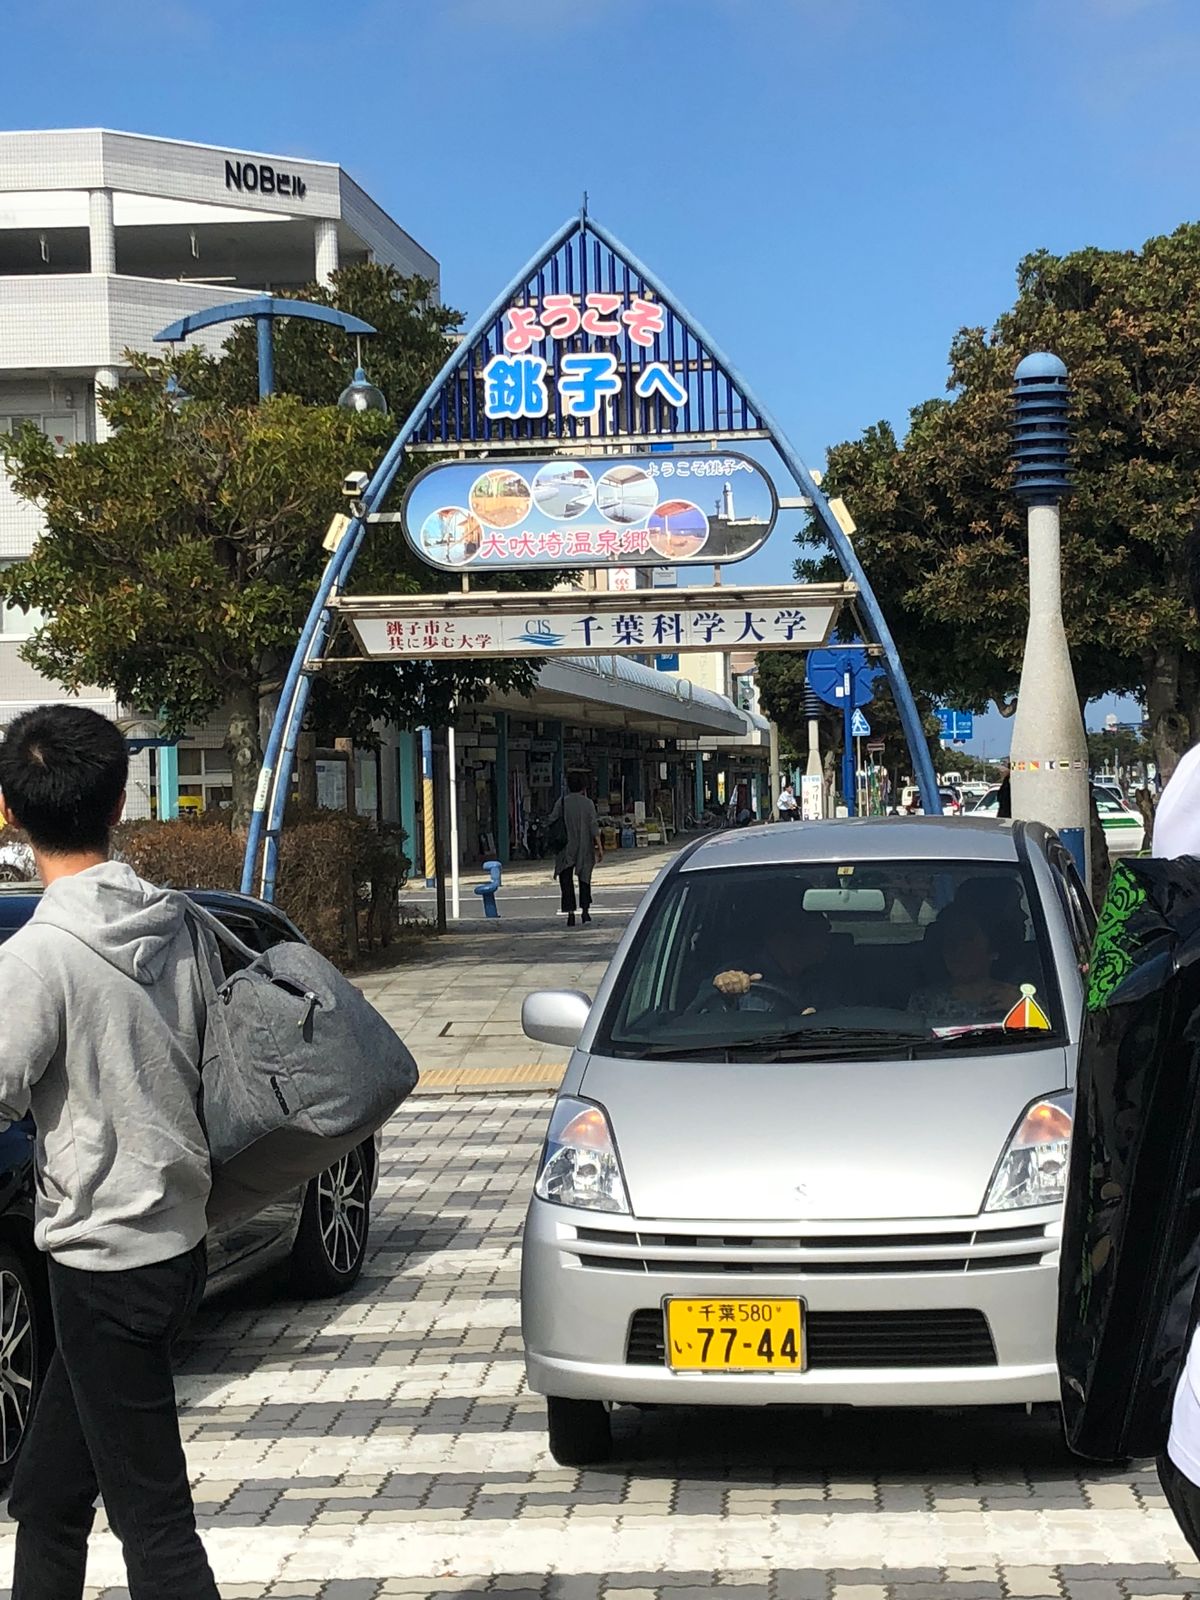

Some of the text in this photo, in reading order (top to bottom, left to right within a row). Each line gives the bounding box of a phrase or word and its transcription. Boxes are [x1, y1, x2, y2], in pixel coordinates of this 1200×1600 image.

[225, 160, 306, 198] NOBビル
[503, 293, 664, 353] ようこそ
[483, 353, 688, 420] 銚子へ
[646, 459, 754, 477] ようこそ銚子へ
[386, 620, 456, 636] 銚子市と
[388, 633, 492, 651] 共に歩む大学
[571, 610, 807, 646] 千葉科学大学
[697, 1328, 798, 1363] 77-44
